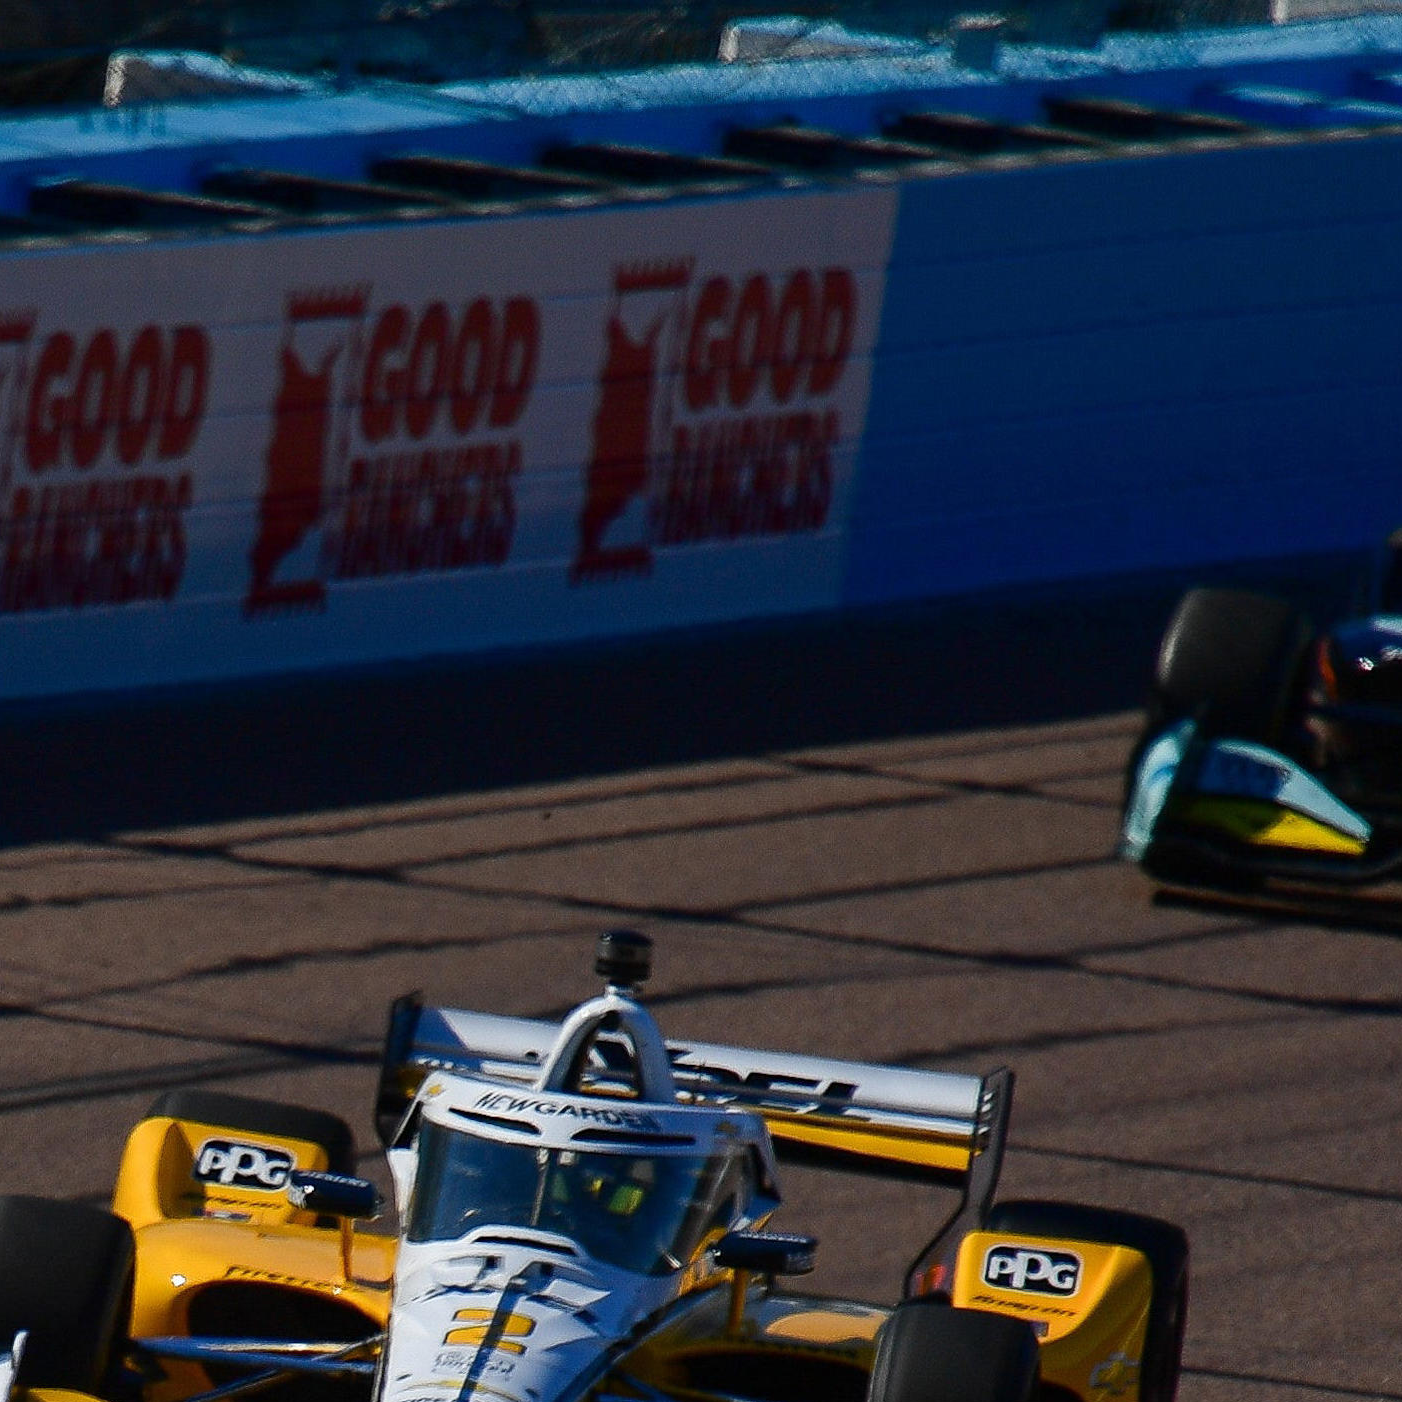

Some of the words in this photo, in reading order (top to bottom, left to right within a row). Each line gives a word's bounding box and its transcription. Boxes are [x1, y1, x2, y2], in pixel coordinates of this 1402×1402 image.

[360, 295, 541, 442] GOOD
[683, 266, 857, 411] GOOD
[24, 324, 210, 472] GOOD
[198, 1144, 291, 1186] PPG
[988, 1250, 1077, 1290] PPG
[443, 1307, 537, 1355] 2
